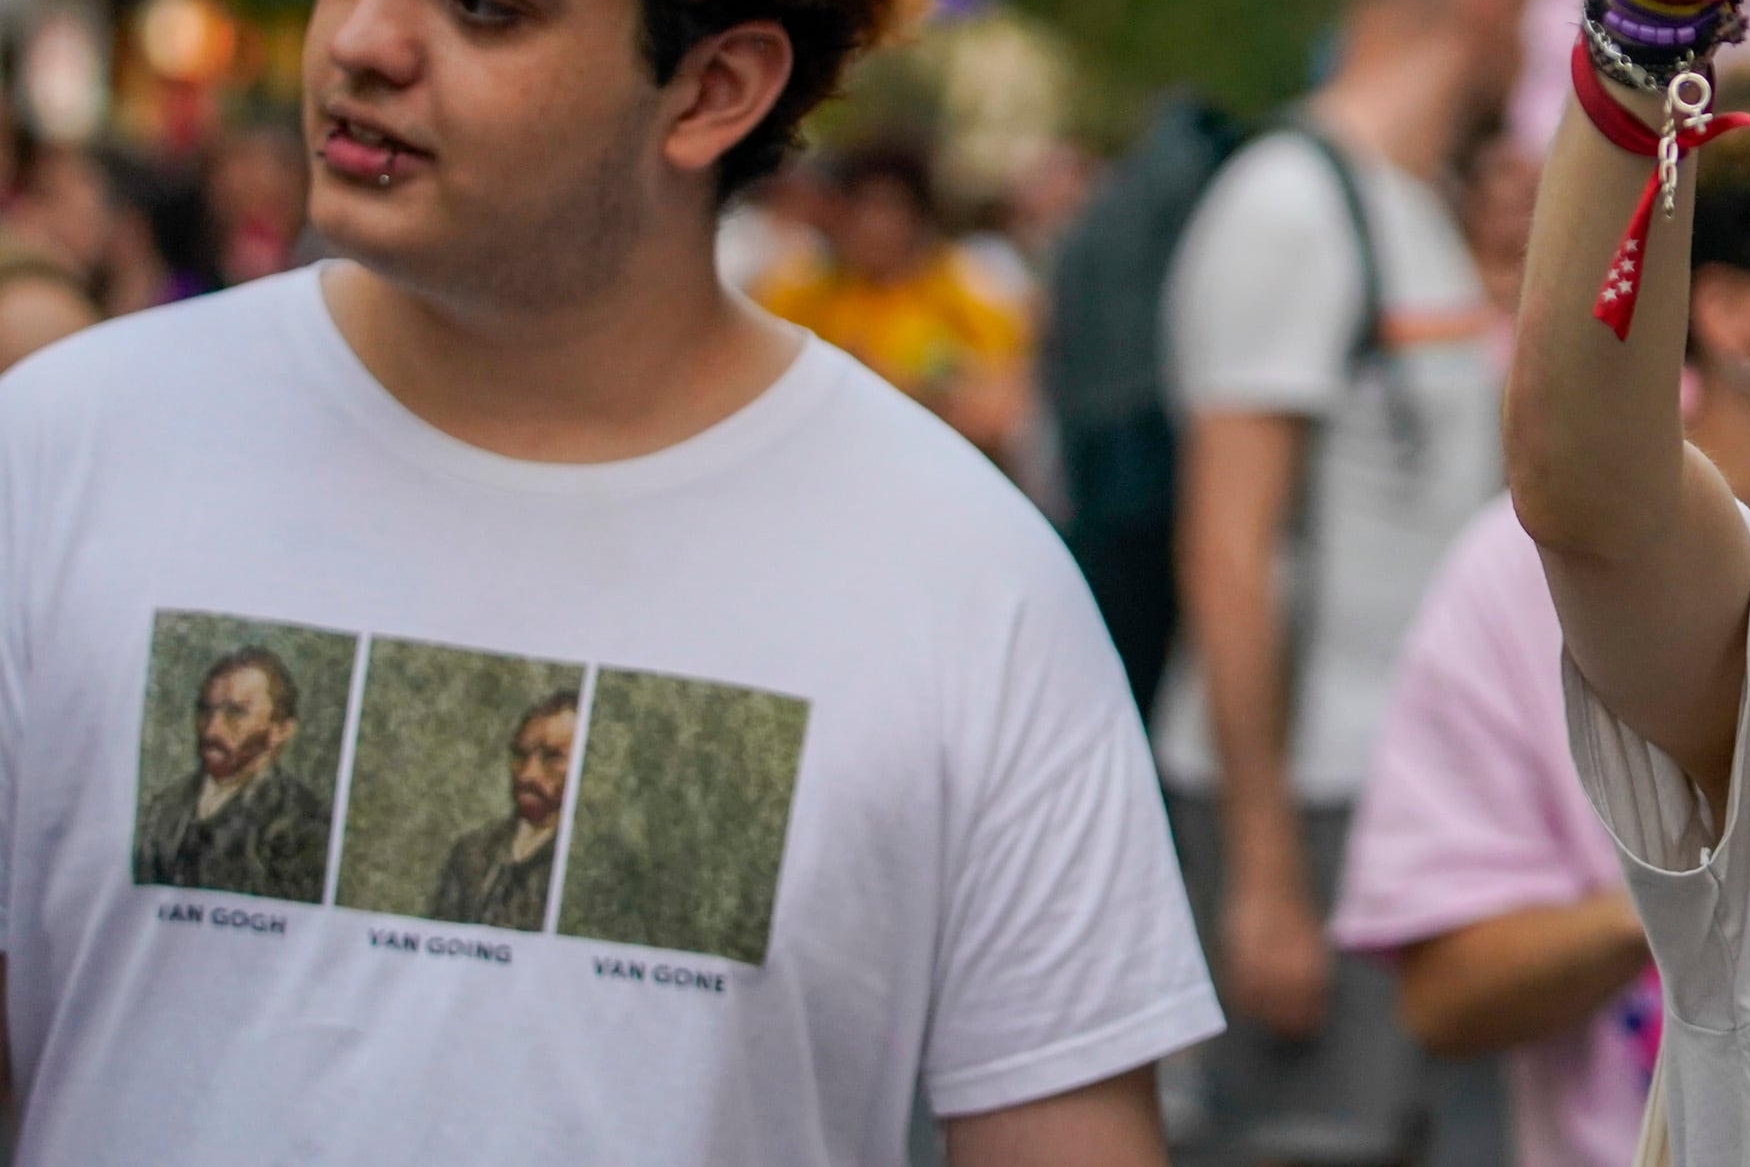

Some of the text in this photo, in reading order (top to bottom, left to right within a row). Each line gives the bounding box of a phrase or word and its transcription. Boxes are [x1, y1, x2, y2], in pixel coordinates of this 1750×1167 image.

[210, 906, 287, 934] GOGH
[369, 927, 513, 963] VAN GOING
[592, 955, 726, 993] VAN GONE
